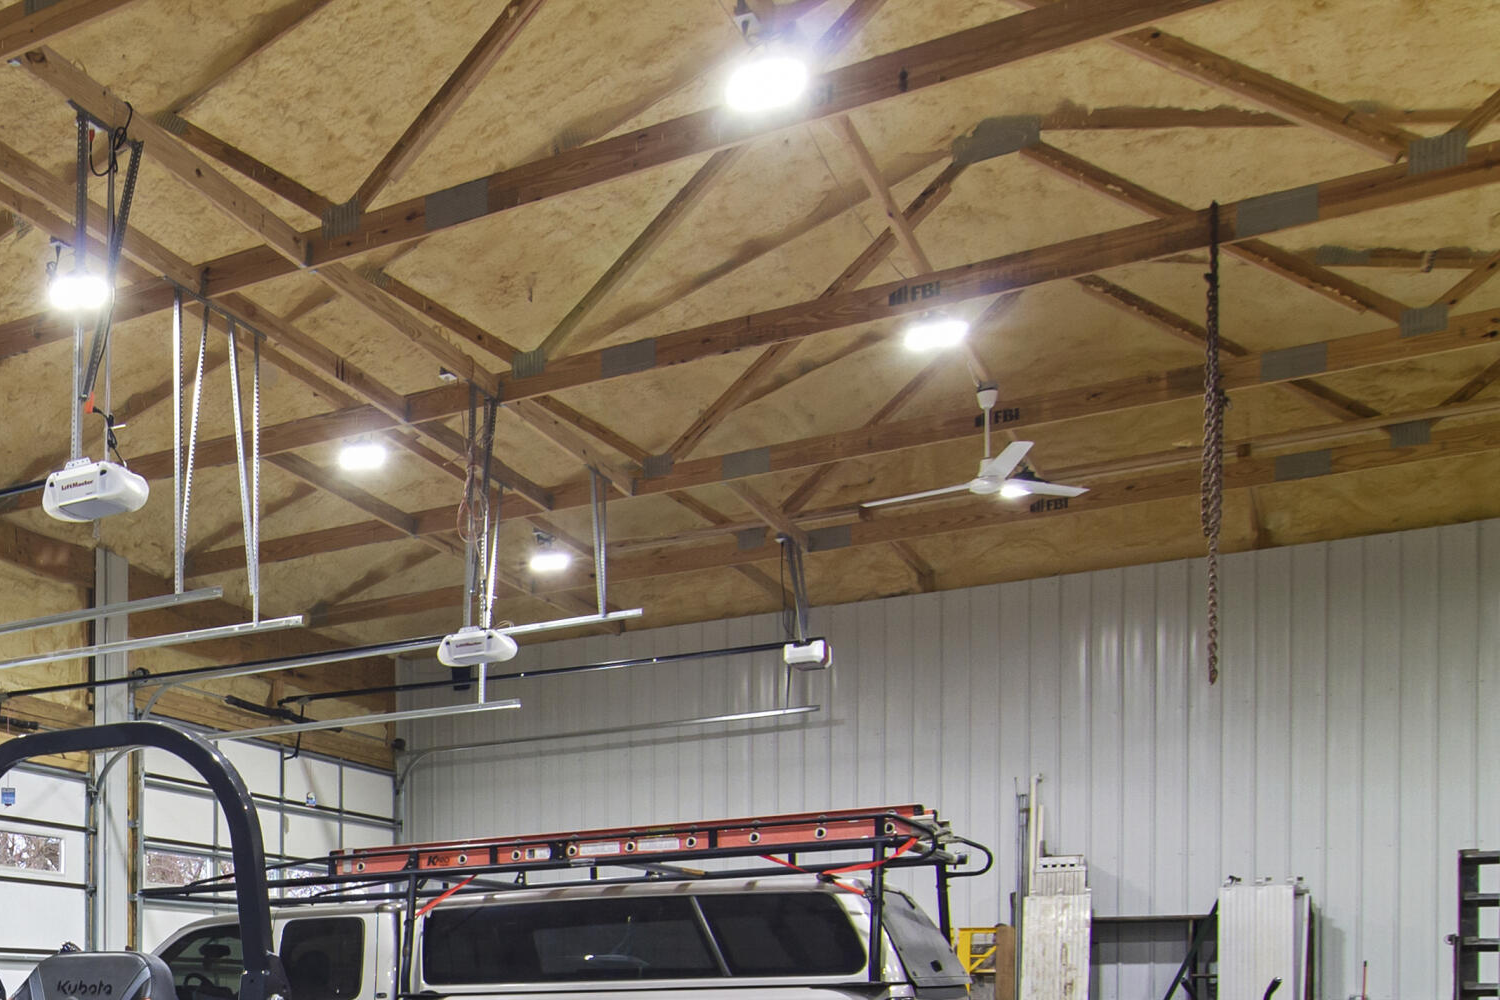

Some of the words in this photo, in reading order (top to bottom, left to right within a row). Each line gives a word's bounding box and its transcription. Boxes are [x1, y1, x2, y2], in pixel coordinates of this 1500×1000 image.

[911, 281, 941, 302] FBI
[994, 408, 1020, 424] FBI
[61, 480, 94, 491] LiftMaster
[1046, 497, 1069, 511] FBI
[57, 980, 113, 995] Kubota
